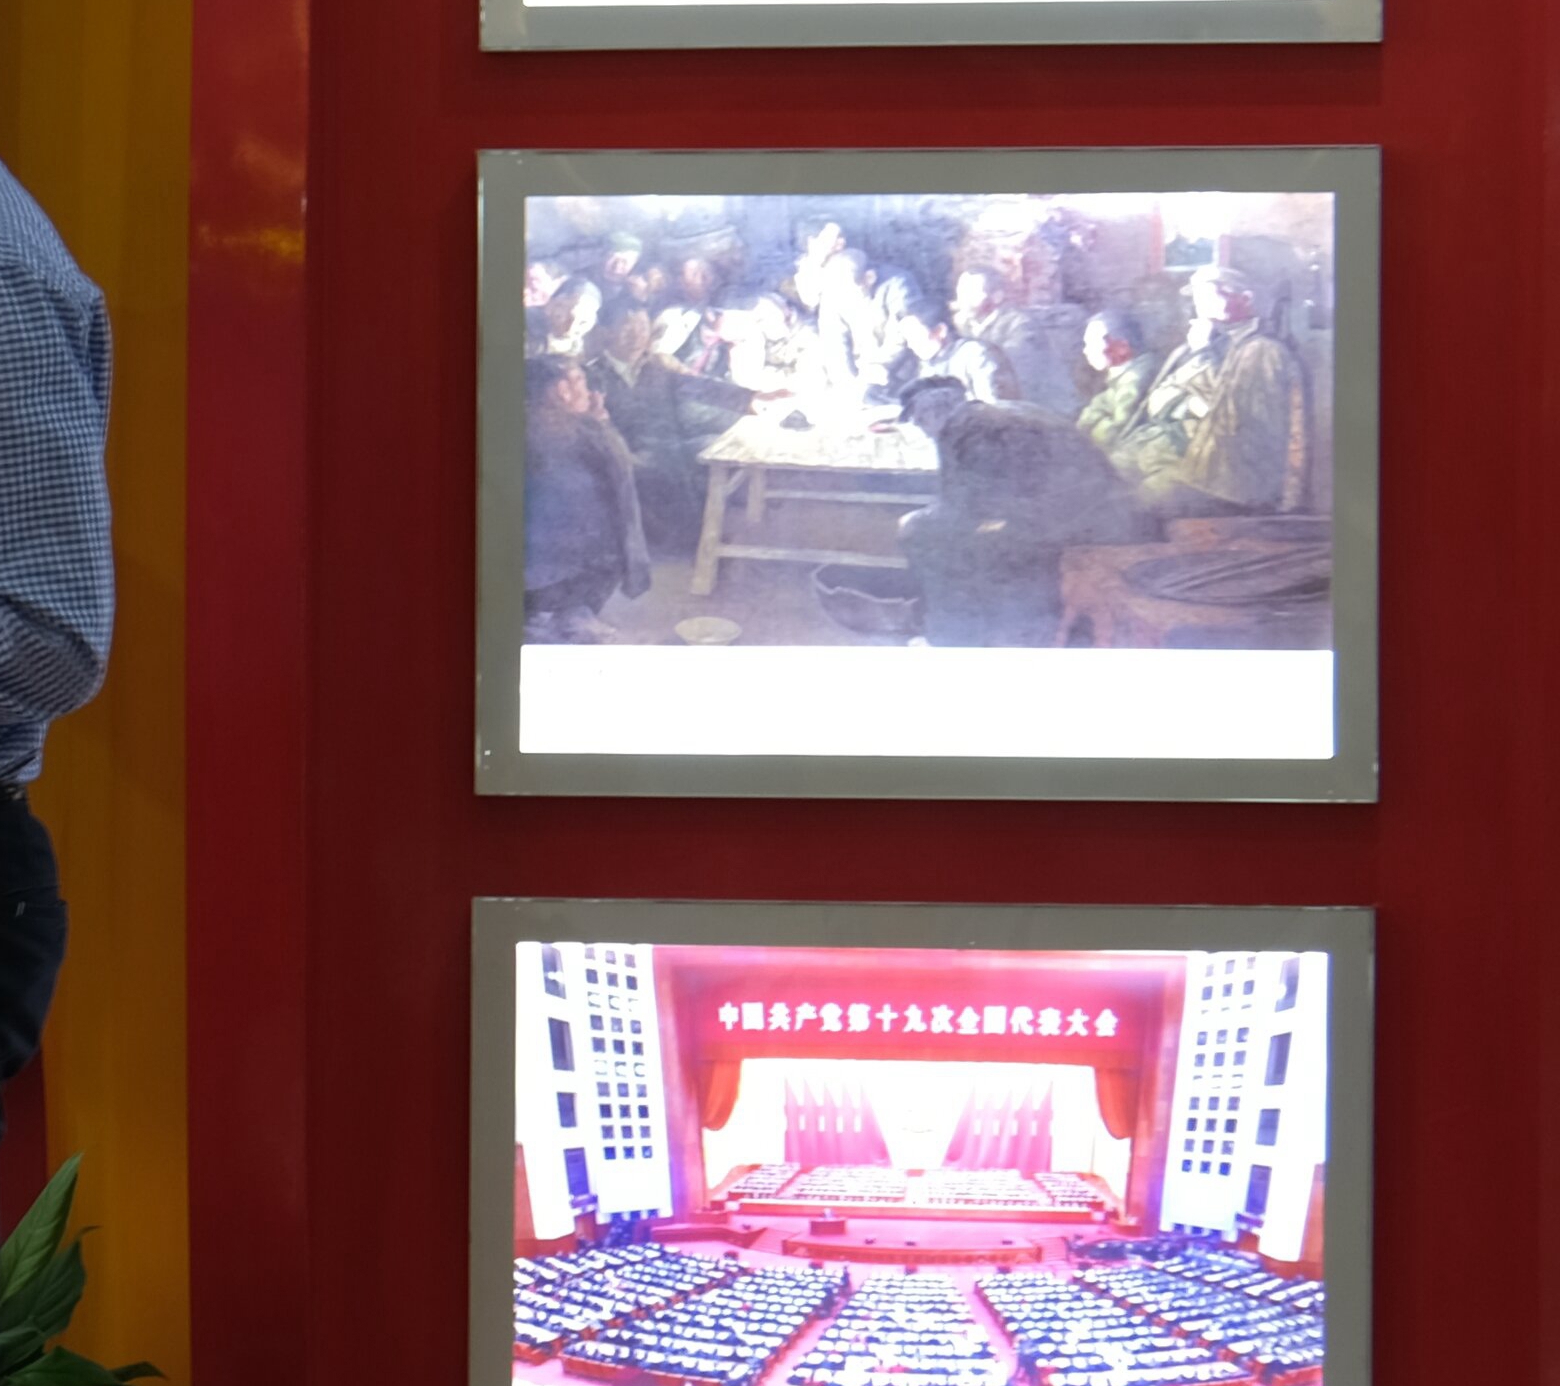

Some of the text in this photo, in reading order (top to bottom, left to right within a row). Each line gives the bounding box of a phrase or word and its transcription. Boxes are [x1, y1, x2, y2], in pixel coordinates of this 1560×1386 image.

[718, 1001, 1119, 1038] 中国共产党第十九次全国代表大会
